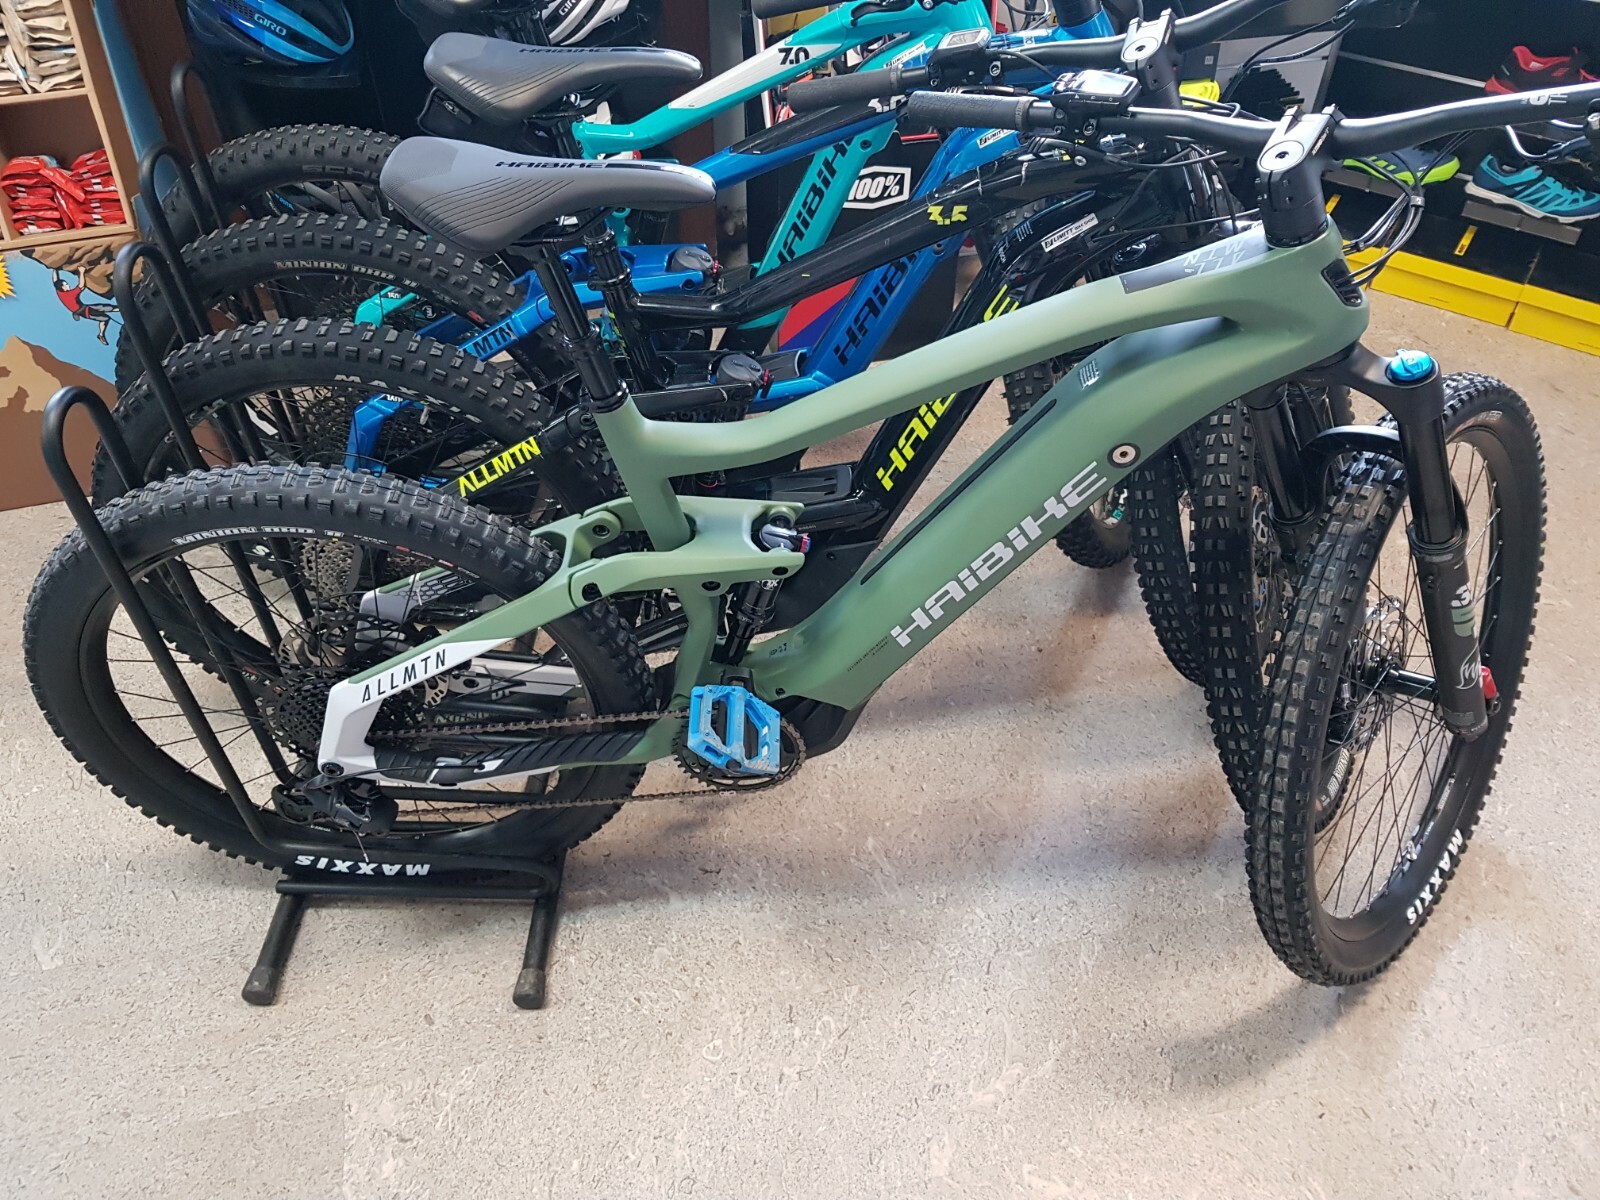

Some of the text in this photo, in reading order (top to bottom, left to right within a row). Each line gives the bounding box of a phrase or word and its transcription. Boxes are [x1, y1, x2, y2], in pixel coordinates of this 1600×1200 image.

[254, 13, 287, 36] GIRO
[848, 174, 901, 201] 100%
[927, 205, 968, 225] 3.5
[463, 322, 513, 358] MTN
[459, 436, 541, 497] ALLMTN
[173, 526, 258, 547] MINION
[362, 649, 446, 703] ALLMTN
[295, 855, 431, 876] MAXXIS
[1406, 828, 1463, 925] MAXXIS
